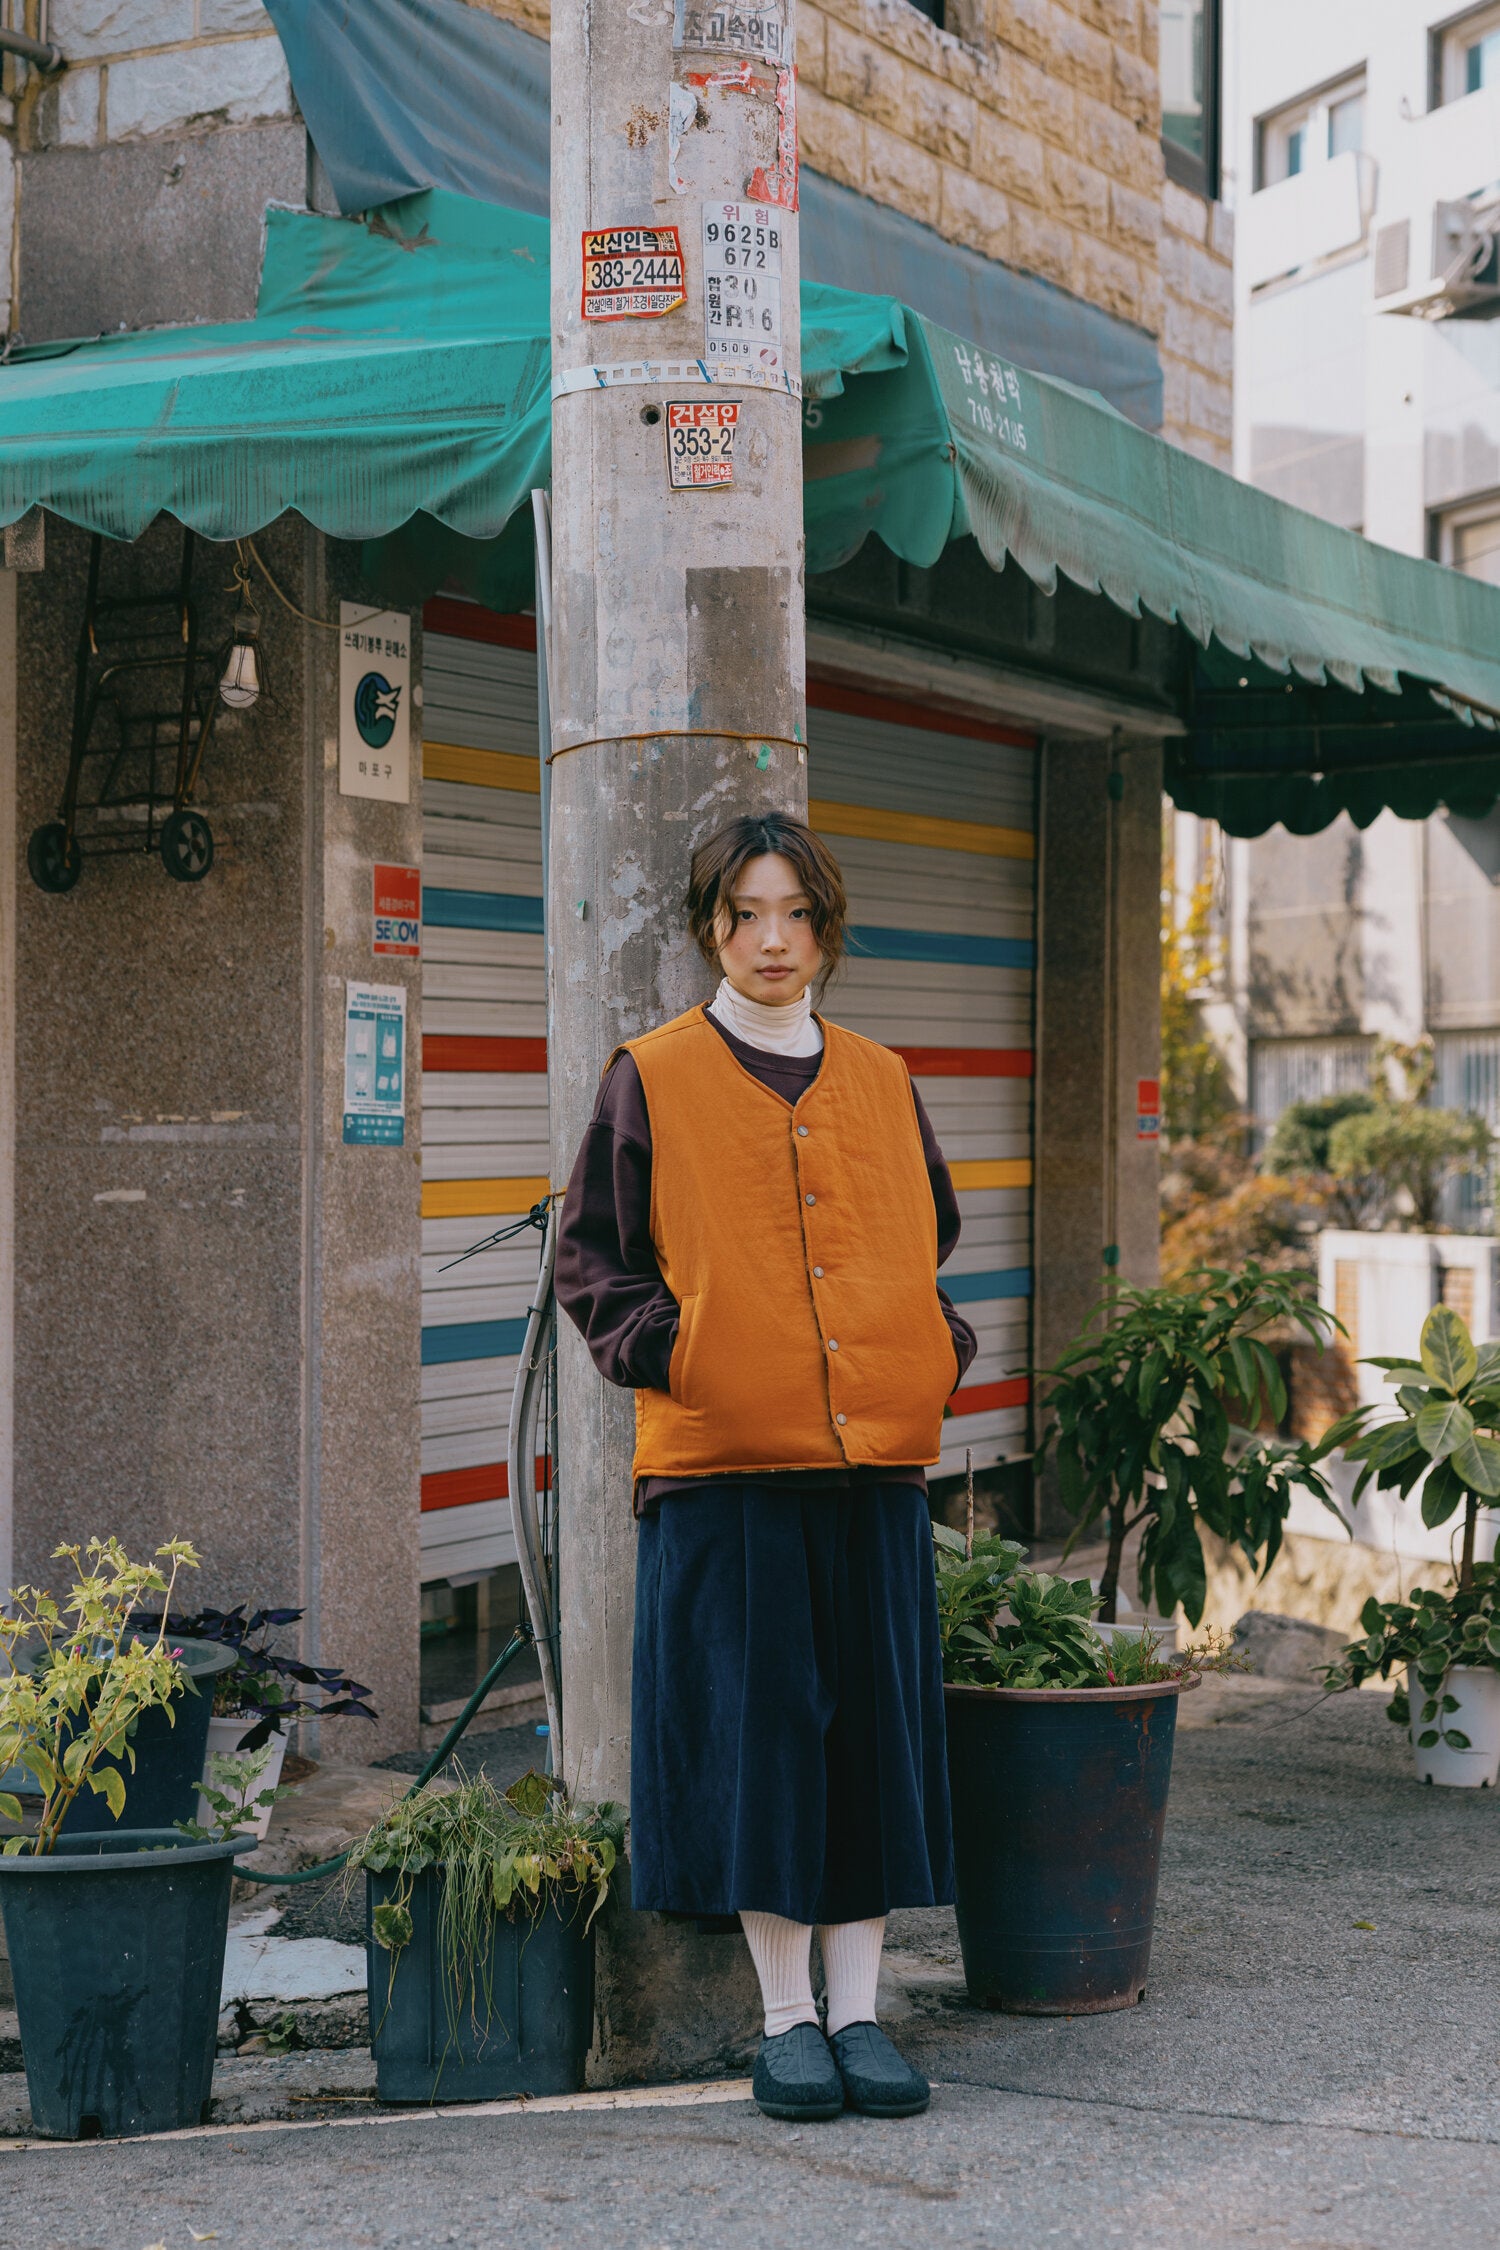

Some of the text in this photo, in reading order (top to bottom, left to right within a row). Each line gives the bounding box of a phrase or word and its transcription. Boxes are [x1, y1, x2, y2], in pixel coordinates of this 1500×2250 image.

[707, 223, 779, 248] 9625B
[724, 247, 766, 268] 672
[591, 258, 681, 289] 383-2444
[724, 275, 758, 300] 30
[633, 294, 649, 310] 조경
[709, 341, 749, 353] 0509
[358, 761, 392, 780] 마포구
[375, 919, 418, 944] SECOM
